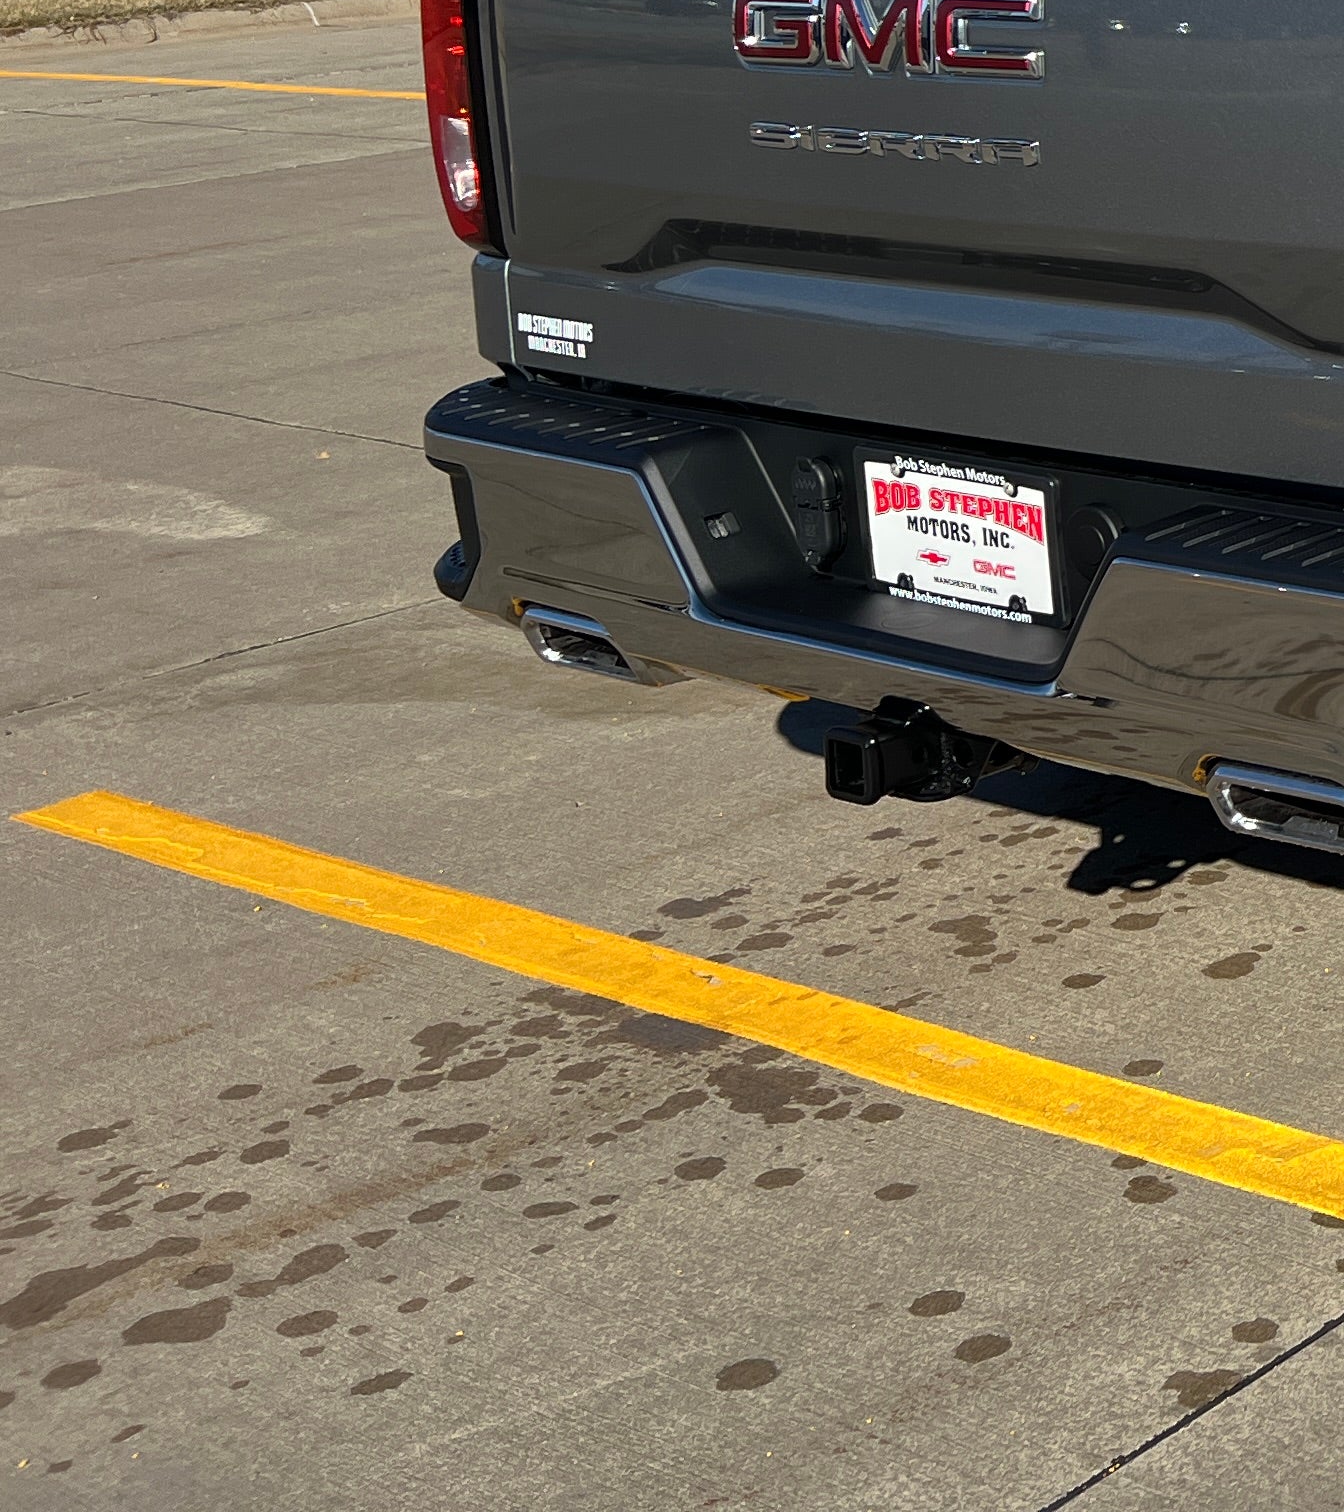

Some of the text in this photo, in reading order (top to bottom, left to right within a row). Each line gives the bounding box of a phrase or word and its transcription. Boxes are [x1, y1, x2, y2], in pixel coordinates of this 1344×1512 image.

[749, 120, 1042, 167] SIERRA
[894, 455, 918, 471] Bob
[918, 459, 965, 480] Stephen
[872, 477, 1045, 546] BOB STEPHEN
[906, 514, 1016, 550] MOTORS, INC.
[972, 558, 1017, 581] GMC
[888, 586, 1032, 624] www.bobstephenmotors.com
